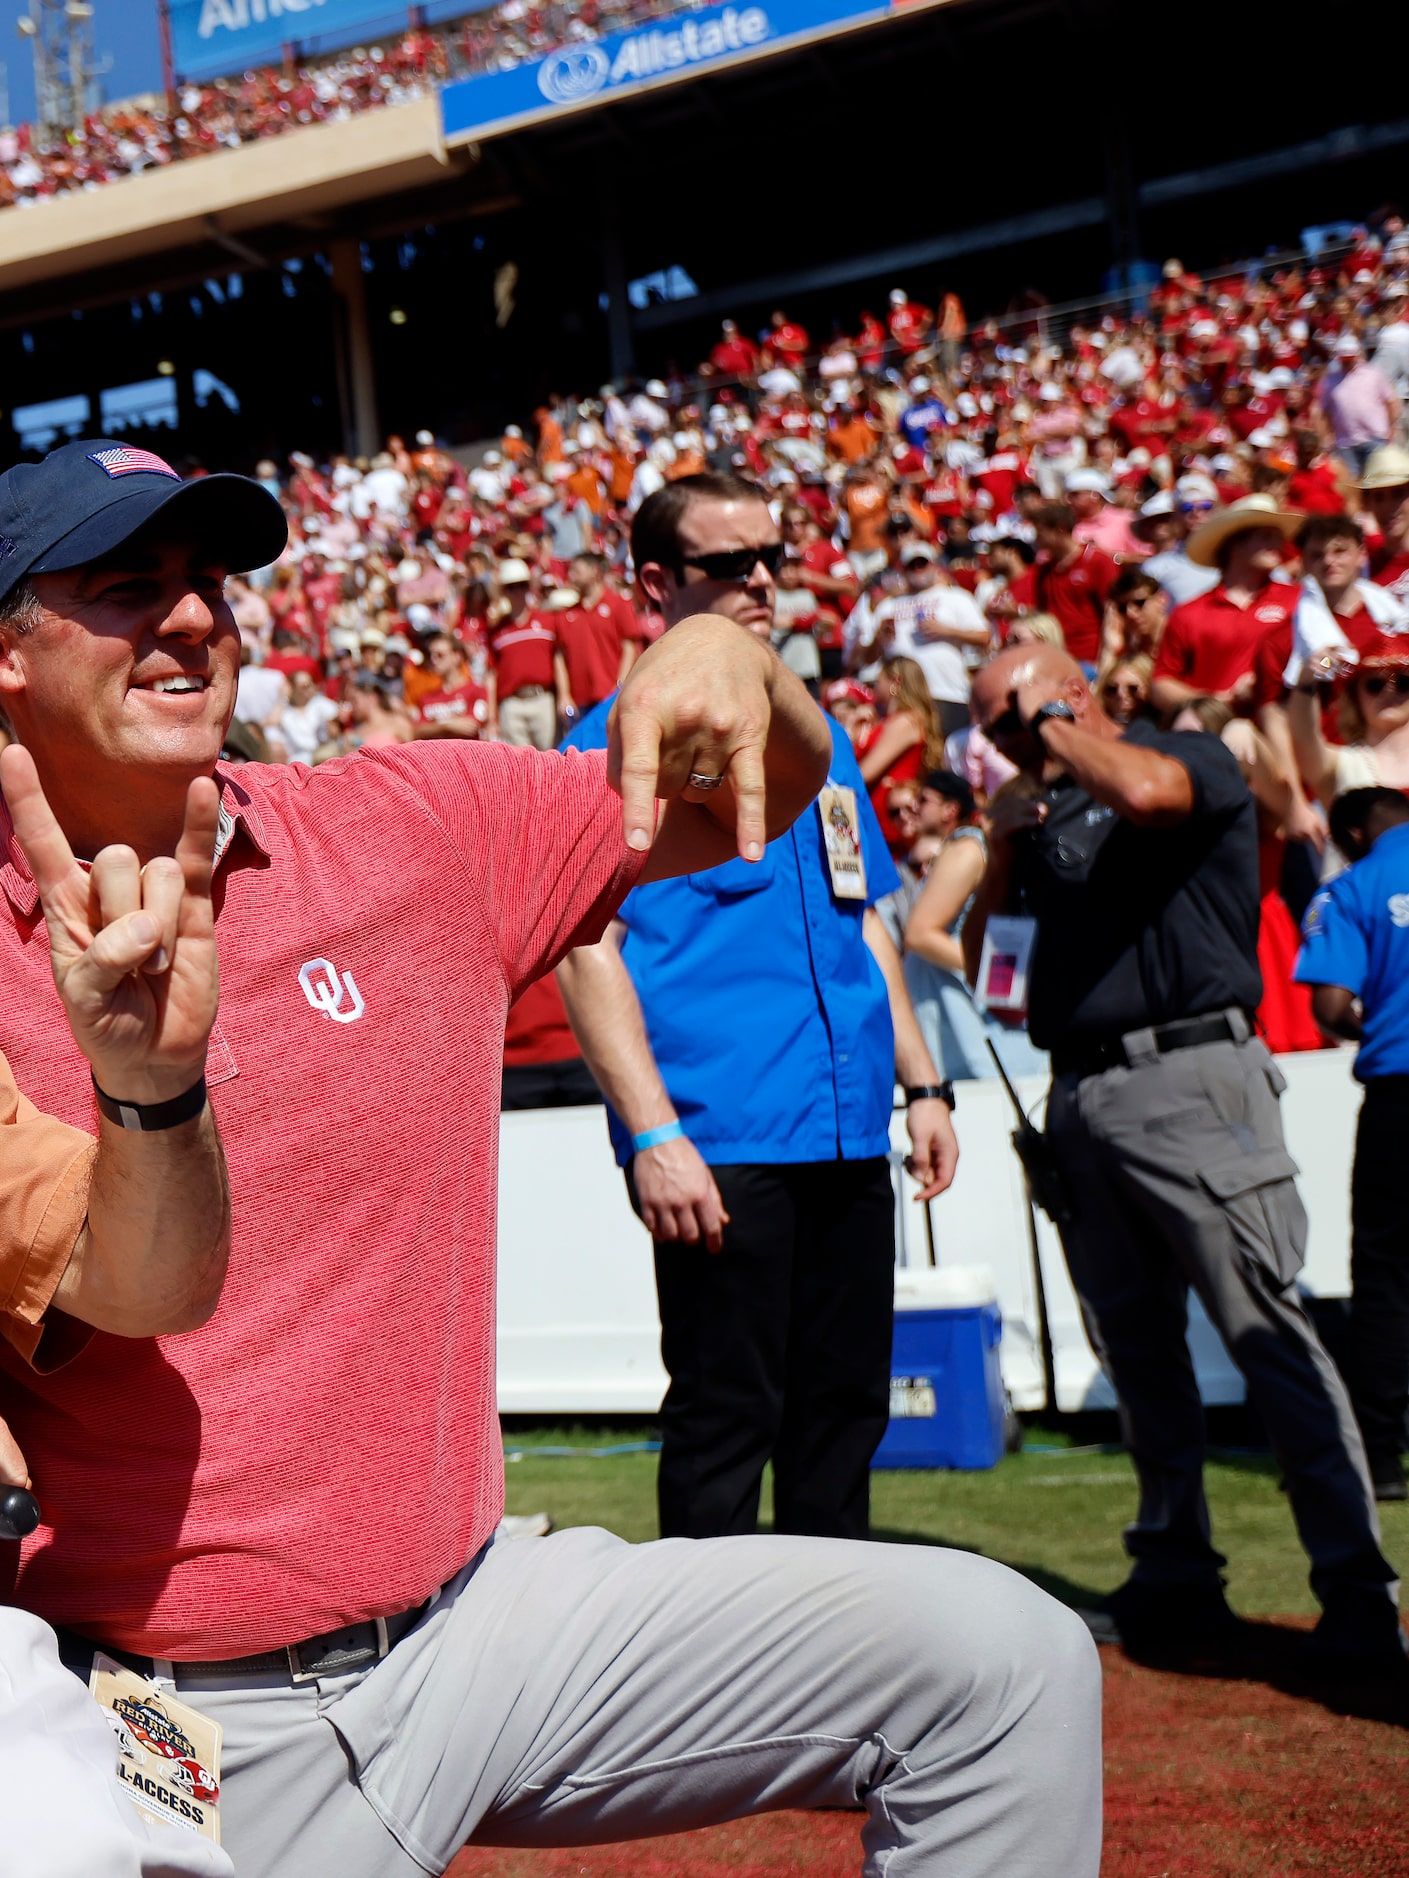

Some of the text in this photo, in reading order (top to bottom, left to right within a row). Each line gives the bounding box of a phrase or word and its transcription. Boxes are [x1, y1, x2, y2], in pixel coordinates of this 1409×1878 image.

[608, 6, 771, 85] Allstate
[297, 957, 366, 1024] OU
[114, 1700, 146, 1724] RED
[148, 1719, 194, 1756] RIVER
[138, 1721, 171, 1744] RIVALRY
[140, 1708, 172, 1731] Allstate
[116, 1763, 204, 1825] L-ACCESS
